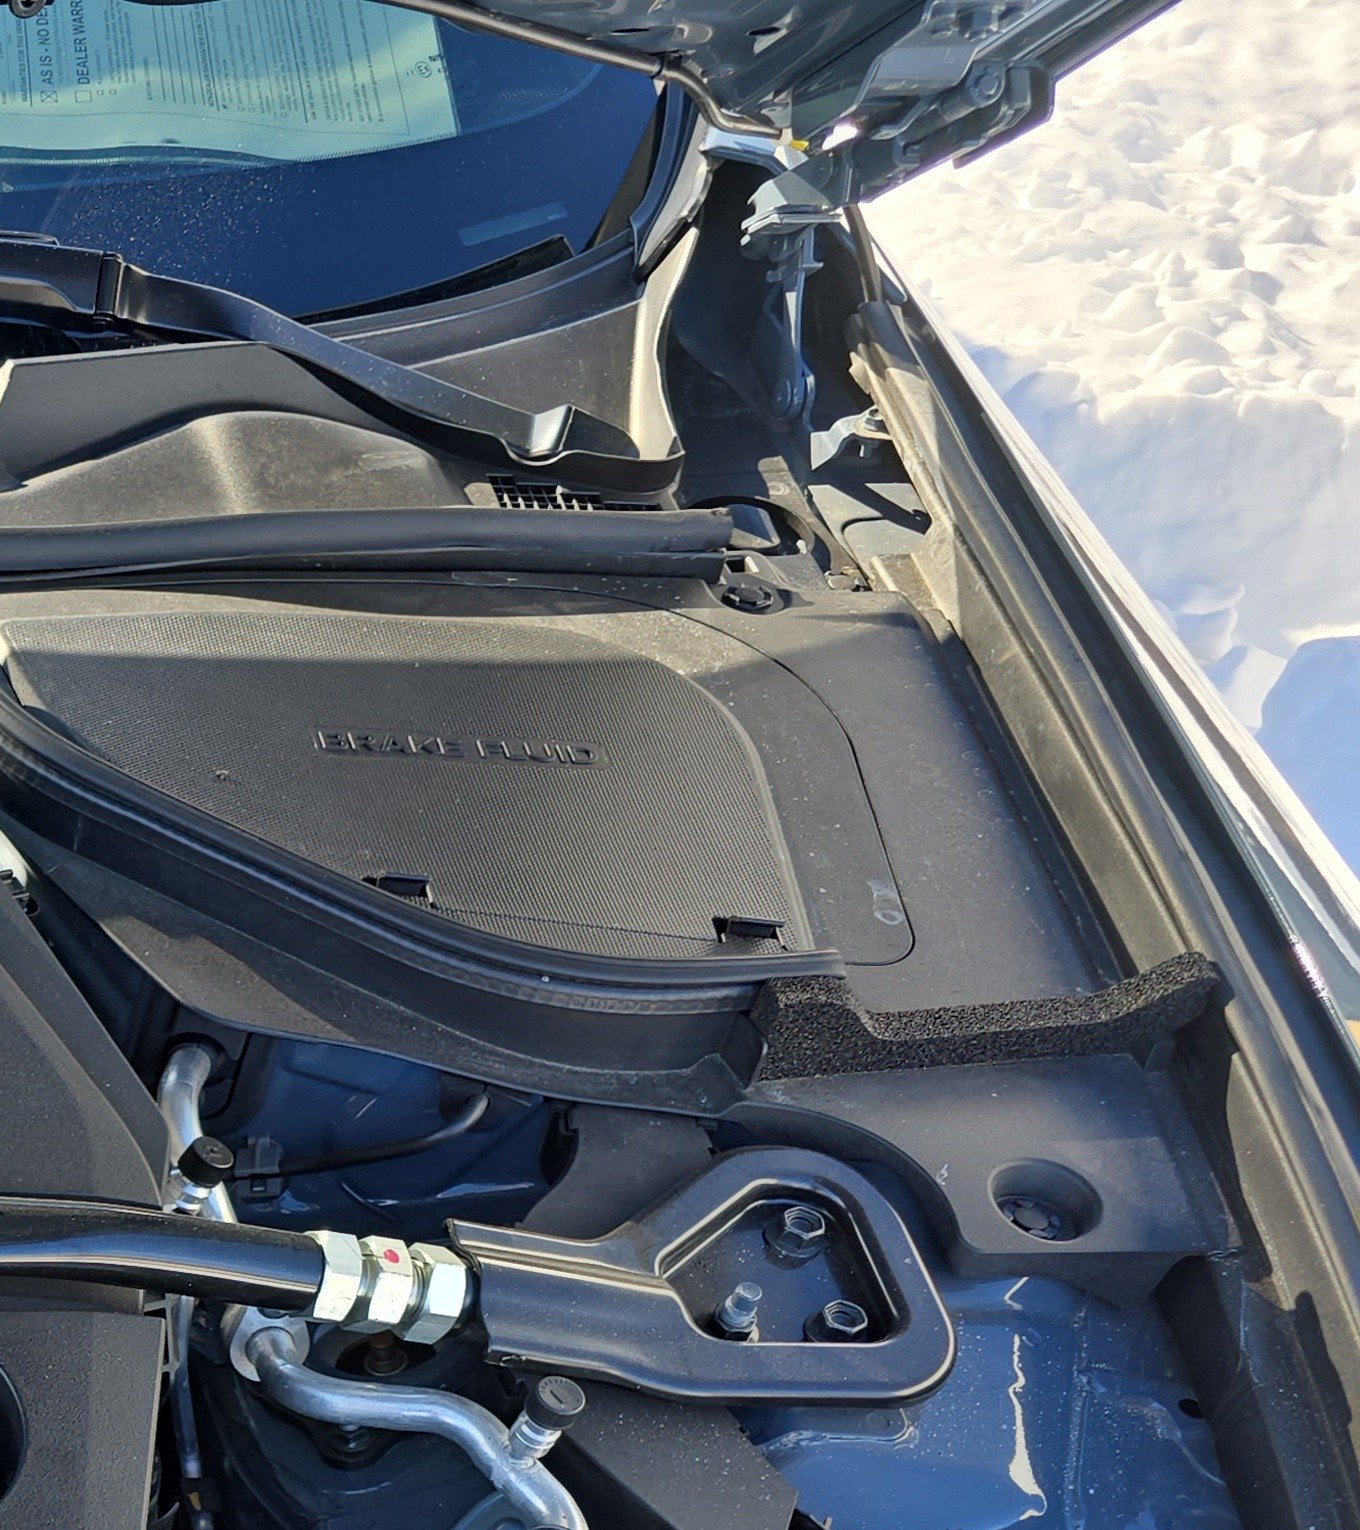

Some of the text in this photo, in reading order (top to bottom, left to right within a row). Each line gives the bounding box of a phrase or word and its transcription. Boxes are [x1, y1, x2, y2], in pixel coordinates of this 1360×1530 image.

[37, 28, 51, 46] NO
[39, 56, 53, 67] IS
[73, 35, 90, 85] DEALER
[40, 69, 54, 85] AS
[317, 730, 598, 765] BRAKE FLUID
